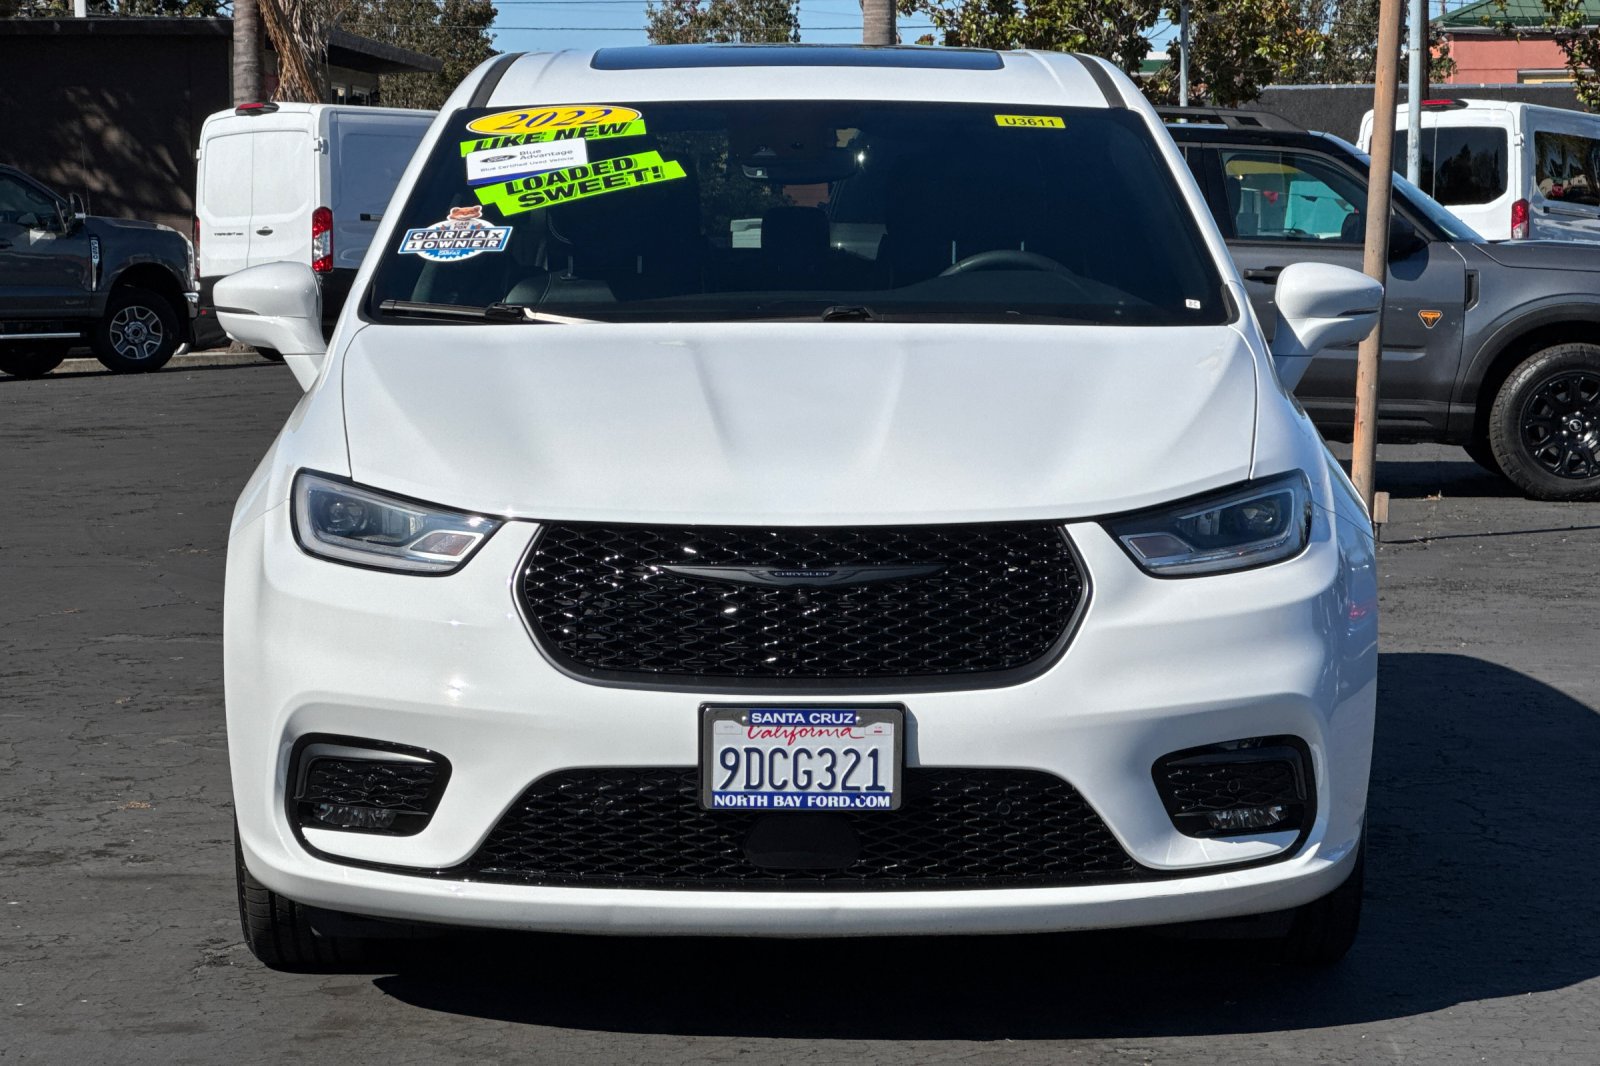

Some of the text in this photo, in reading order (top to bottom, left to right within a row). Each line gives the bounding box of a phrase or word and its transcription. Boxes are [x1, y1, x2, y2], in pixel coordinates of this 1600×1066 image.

[494, 109, 613, 130] 2022
[1004, 117, 1056, 127] U3611
[473, 122, 632, 150] LIKE NEW
[519, 150, 573, 160] Advantage
[504, 157, 639, 196] LOADED
[517, 165, 666, 208] SWEET!
[412, 230, 502, 240] CARFAX
[408, 241, 417, 249] 1
[423, 239, 500, 249] OWNER
[751, 712, 854, 724] SANTA CRUZ
[747, 725, 865, 746] California
[719, 746, 886, 791] 9DCG321
[714, 794, 890, 808] NORTH BAY FORD.COM
